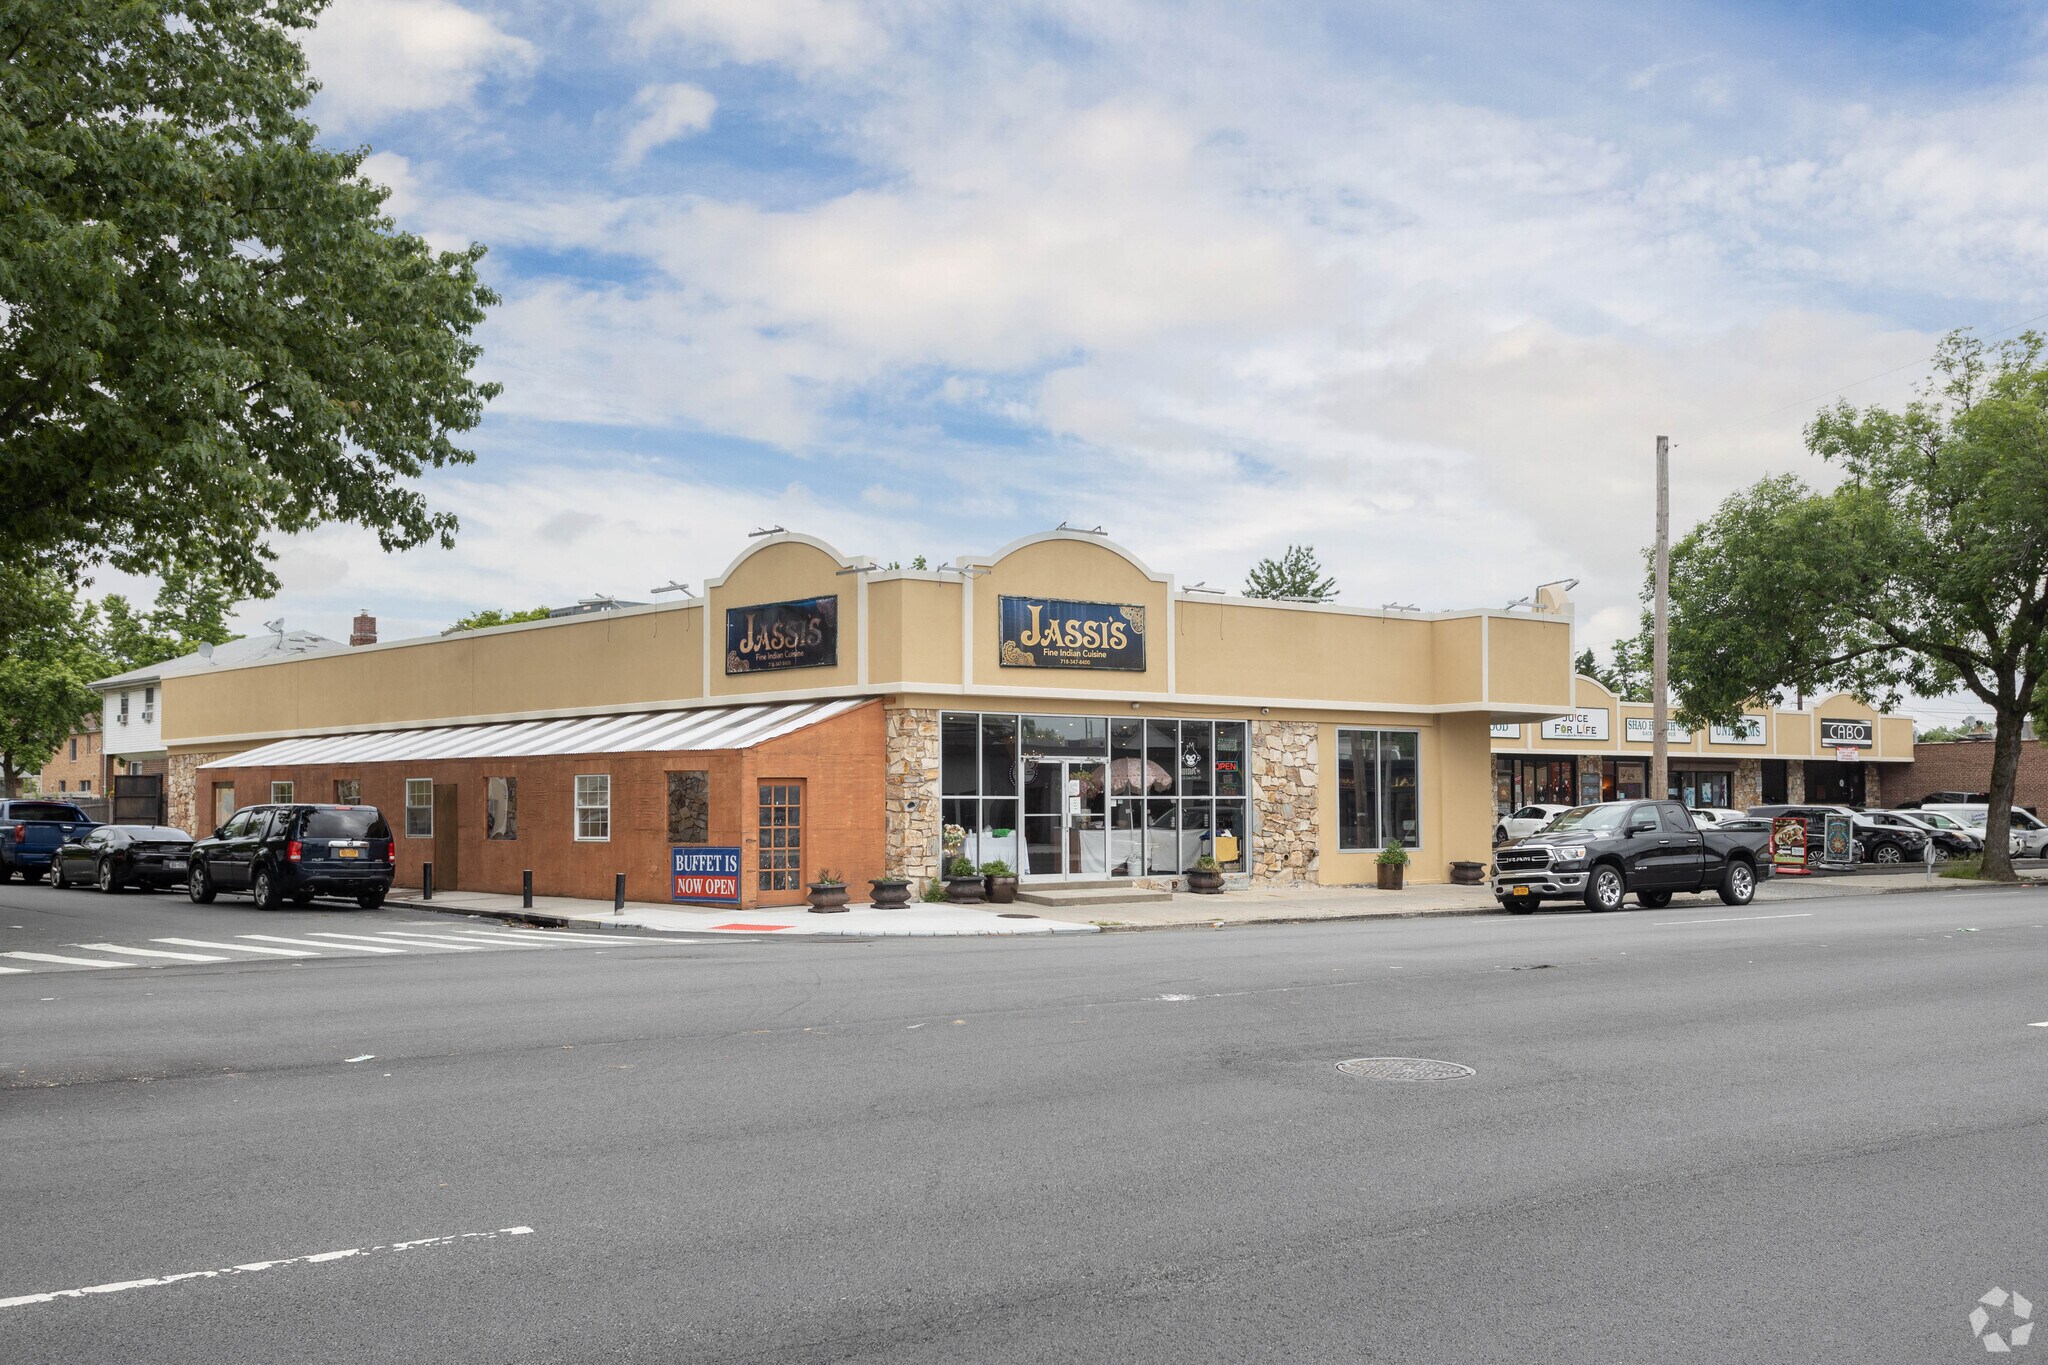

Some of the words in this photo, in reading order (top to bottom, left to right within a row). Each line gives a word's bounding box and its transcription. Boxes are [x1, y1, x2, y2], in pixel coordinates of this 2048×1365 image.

[739, 613, 823, 654] JASSI'S
[1020, 605, 1128, 650] JASSI'S
[755, 653, 767, 661] Fine
[767, 651, 784, 660] Indian
[784, 650, 805, 659] Cuisine
[1043, 649, 1058, 657] Fine
[1060, 649, 1081, 658] Indian
[1082, 649, 1107, 659] Cuisine
[1060, 658, 1091, 666] 718-347-8400
[1562, 711, 1589, 723] JUICE
[1554, 724, 1573, 734] FOR
[1576, 723, 1597, 735] LIFE
[1627, 720, 1648, 730] SHAO
[1648, 721, 1676, 731] HTH
[1715, 725, 1761, 737] UNIMS
[1829, 725, 1865, 740] CABO
[1215, 762, 1237, 771] OPEN
[675, 854, 722, 872] BUFFET
[724, 855, 738, 872] IS
[677, 877, 704, 894] NOW
[705, 878, 736, 895] OPEN
